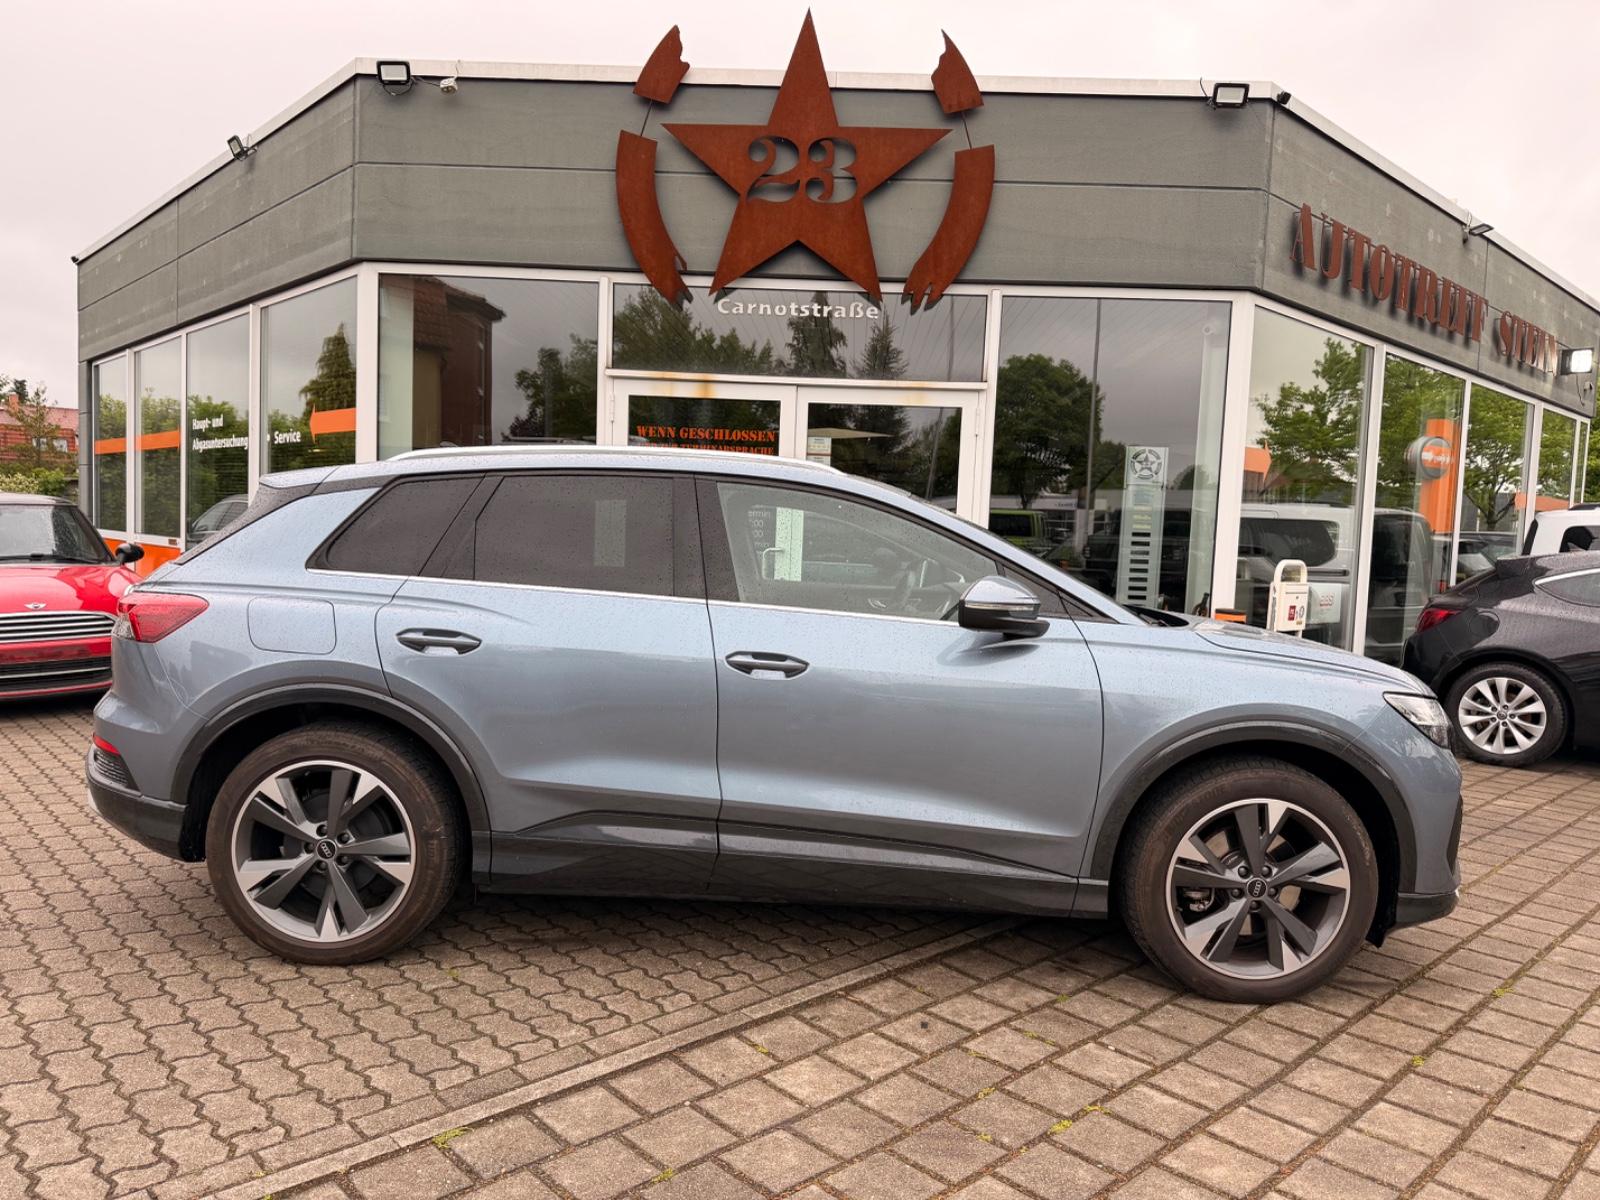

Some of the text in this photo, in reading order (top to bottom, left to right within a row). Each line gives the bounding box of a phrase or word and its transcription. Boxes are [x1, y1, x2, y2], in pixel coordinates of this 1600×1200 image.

[746, 135, 858, 204] 23
[716, 298, 879, 320] Carnotstraße
[212, 413, 223, 428] und
[273, 428, 301, 445] Service
[636, 425, 775, 442] WENN GESCHLOSSEN
